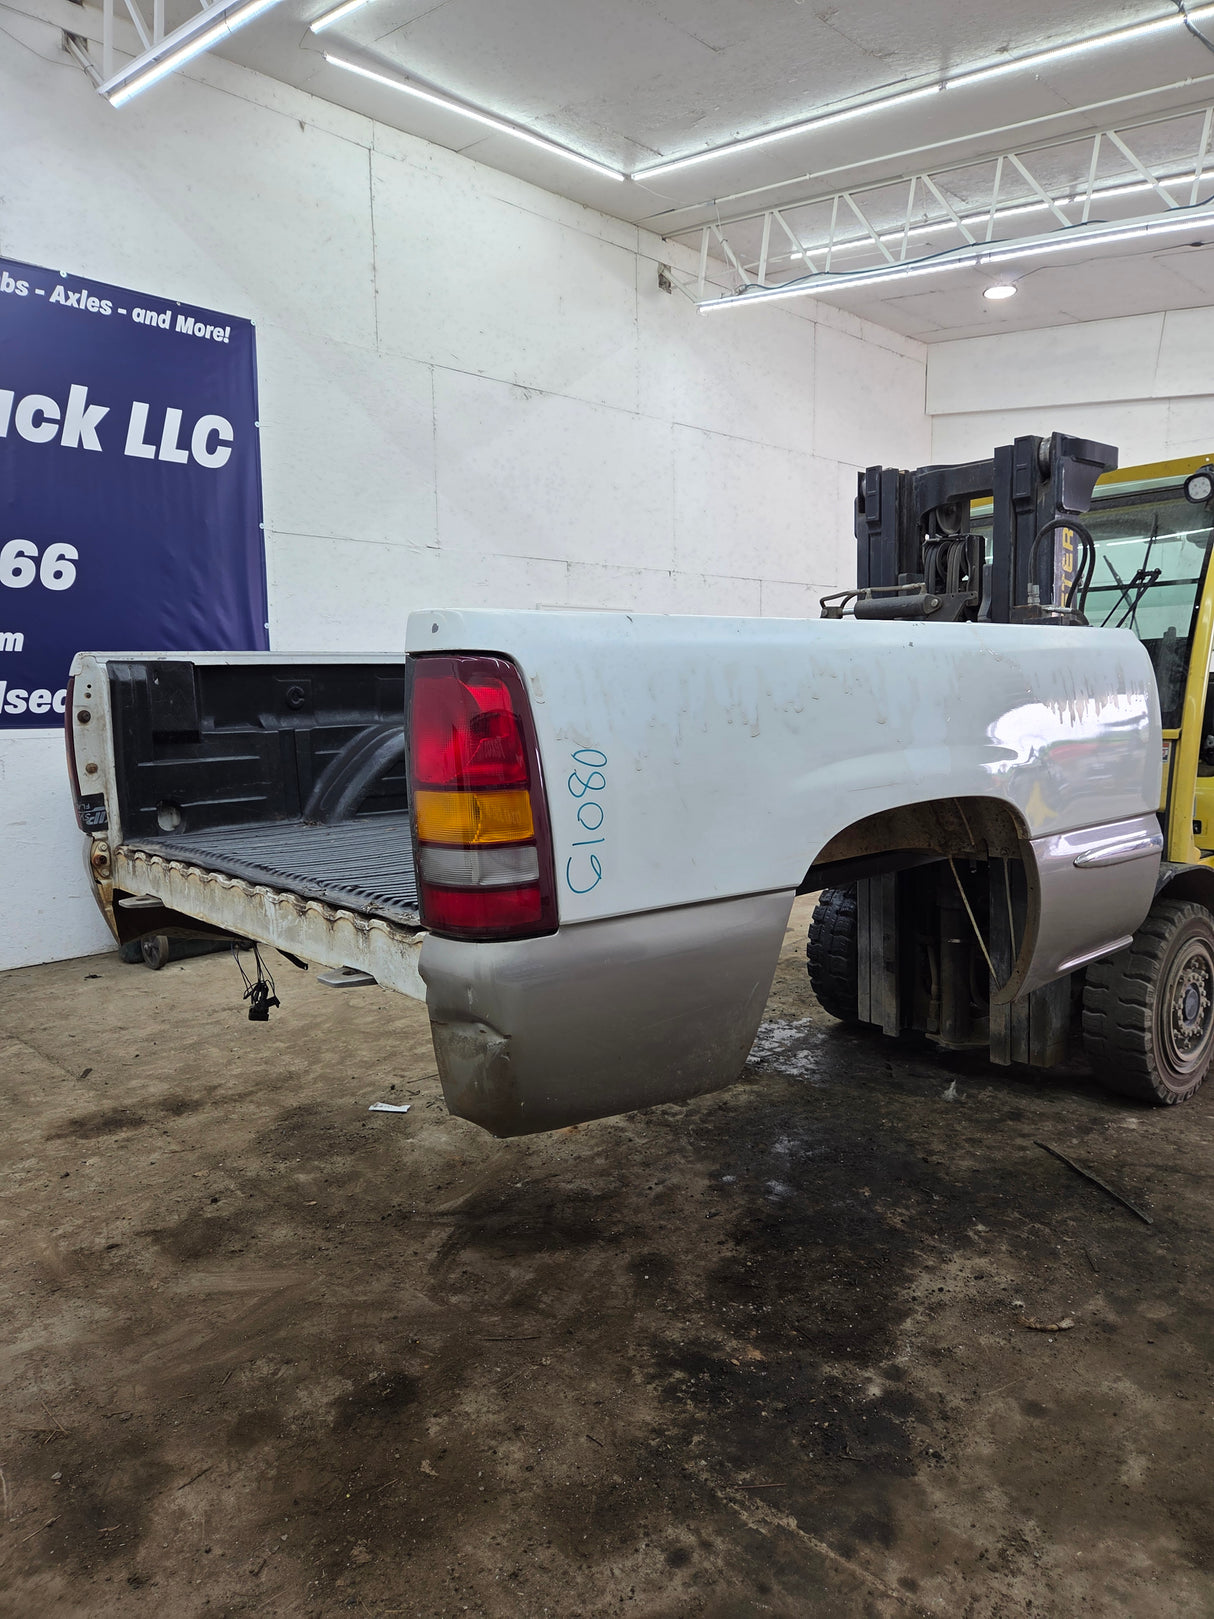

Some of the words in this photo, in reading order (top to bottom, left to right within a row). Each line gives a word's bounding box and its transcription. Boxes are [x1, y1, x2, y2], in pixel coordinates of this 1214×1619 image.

[0, 271, 29, 296] bs
[49, 284, 113, 316] Axles
[132, 307, 172, 330] and
[175, 314, 231, 344] More!
[124, 401, 234, 469] LLC
[0, 539, 79, 591] 66
